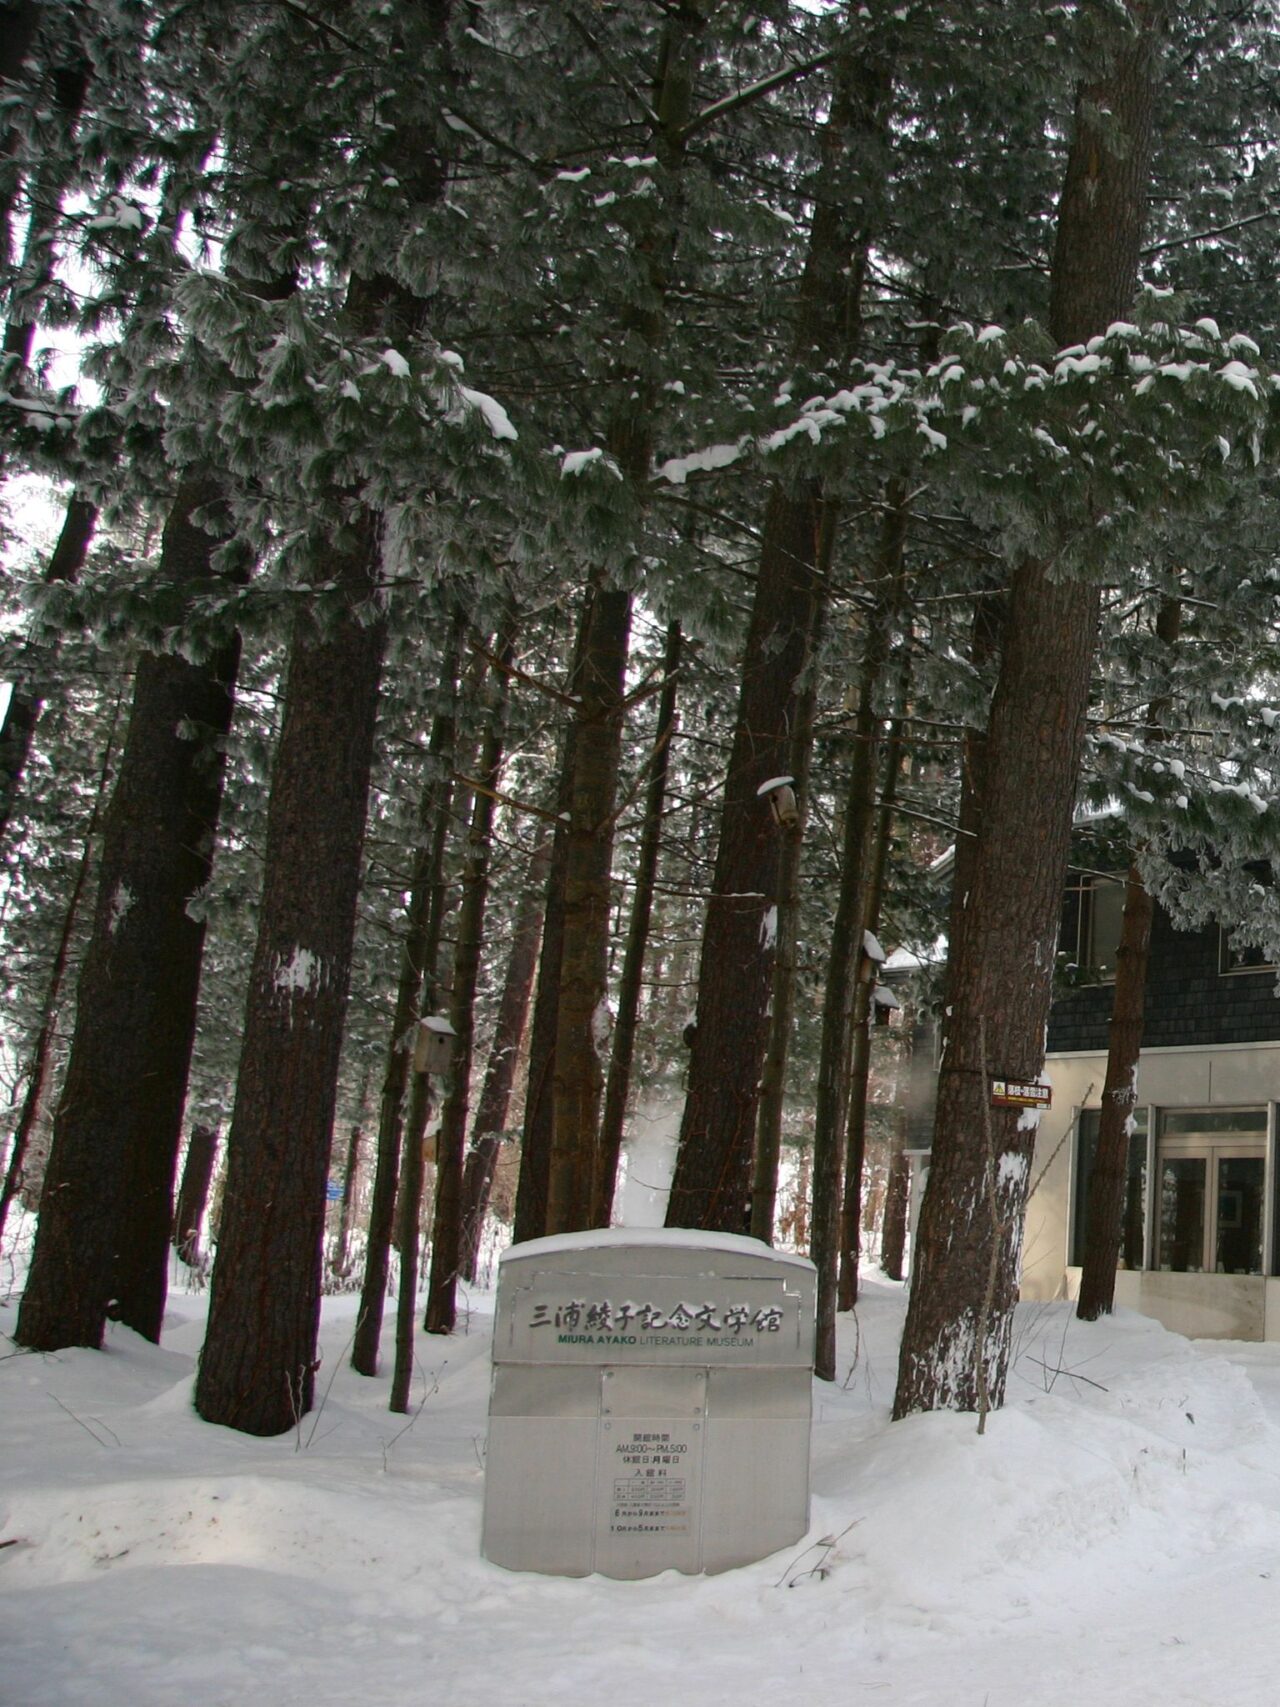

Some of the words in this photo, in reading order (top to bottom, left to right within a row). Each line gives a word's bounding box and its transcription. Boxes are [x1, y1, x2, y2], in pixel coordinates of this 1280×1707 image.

[529, 1302, 784, 1334] 三浦綾子記念文学館
[558, 1335, 594, 1345] MIURA
[596, 1336, 637, 1345] AYAKO
[640, 1336, 703, 1347] LITERATURE
[706, 1338, 754, 1347] MUSEUM
